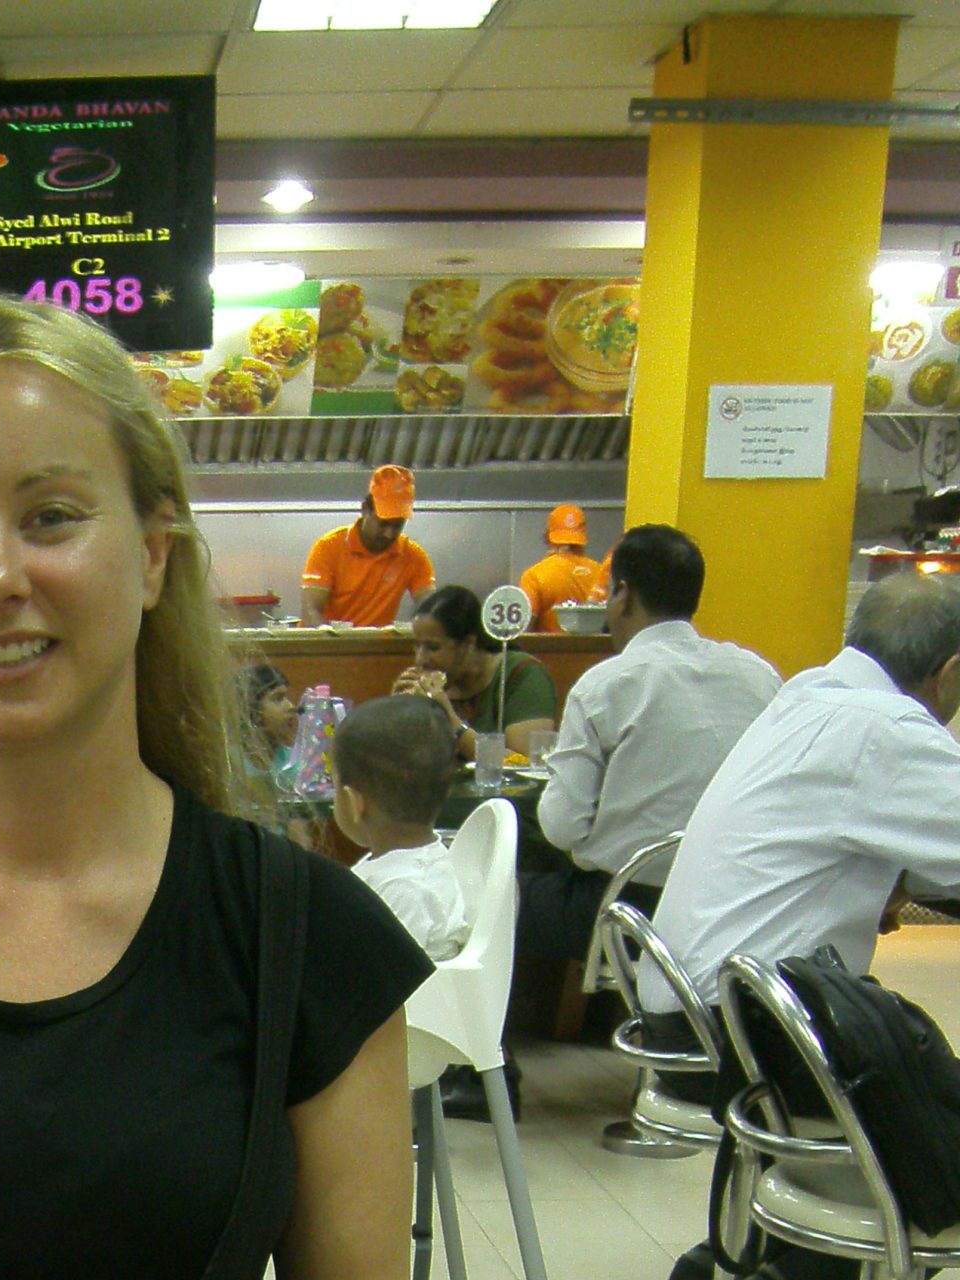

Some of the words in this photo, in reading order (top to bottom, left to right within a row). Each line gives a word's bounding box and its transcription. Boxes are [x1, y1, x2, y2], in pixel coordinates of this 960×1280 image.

[76, 101, 170, 116] BHAVAN
[7, 119, 134, 133] Vegetarian
[39, 213, 81, 228] Alwi
[85, 211, 134, 225] Road
[66, 228, 154, 245] Terminal
[156, 227, 171, 242] 2
[71, 257, 106, 276] C2
[491, 602, 523, 626] 36
